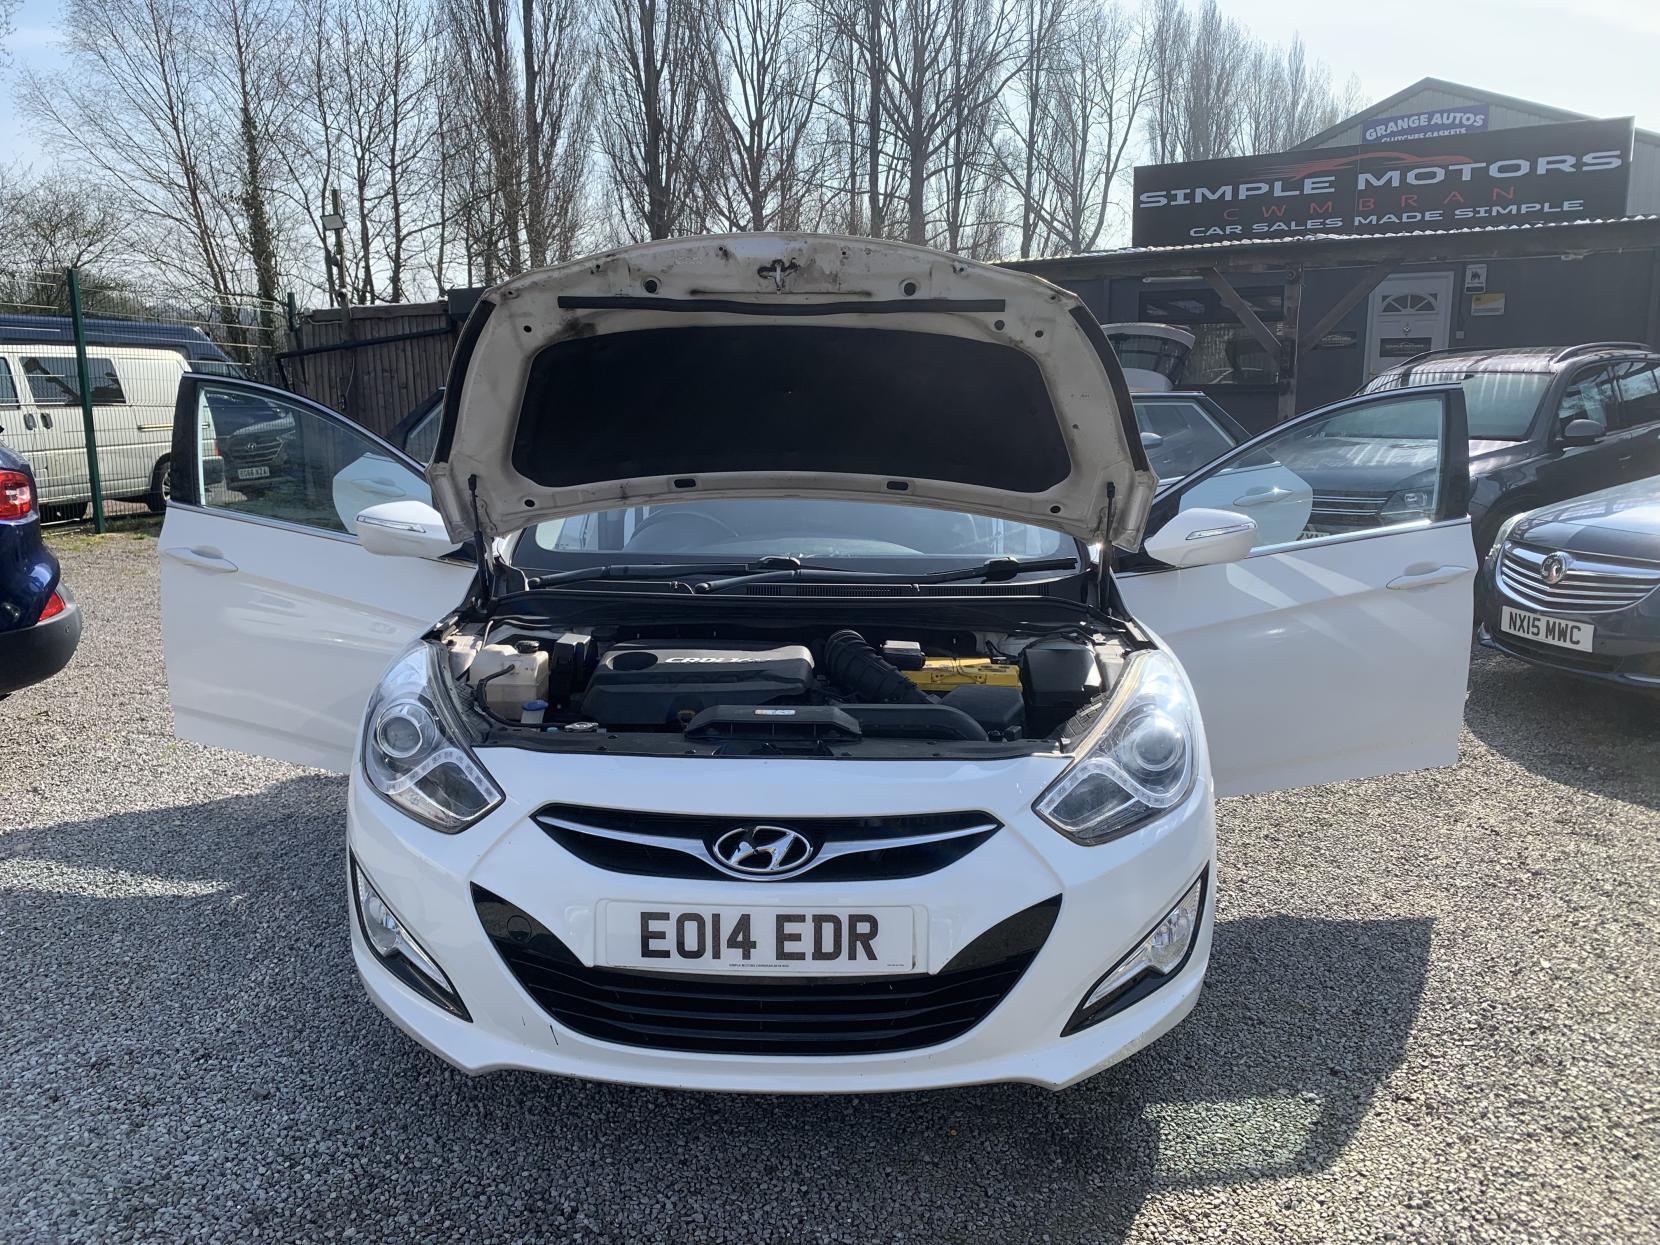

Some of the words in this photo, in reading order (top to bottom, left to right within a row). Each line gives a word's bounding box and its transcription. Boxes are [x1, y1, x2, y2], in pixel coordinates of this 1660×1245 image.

[1365, 114, 1428, 140] GRANGE
[1430, 112, 1485, 127] AUTOS
[1139, 176, 1336, 208] SIMPLE
[1357, 150, 1622, 190] MOTORS
[1189, 225, 1242, 237] CAR
[1252, 217, 1343, 233] SALES
[1354, 210, 1444, 226] MADE
[1454, 200, 1585, 219] SIMPLE
[1223, 186, 1516, 220] CWMBRAN
[1508, 611, 1541, 637] NX15
[1545, 619, 1582, 646] MWC
[640, 911, 757, 961] EO14
[775, 913, 879, 961] EDR
